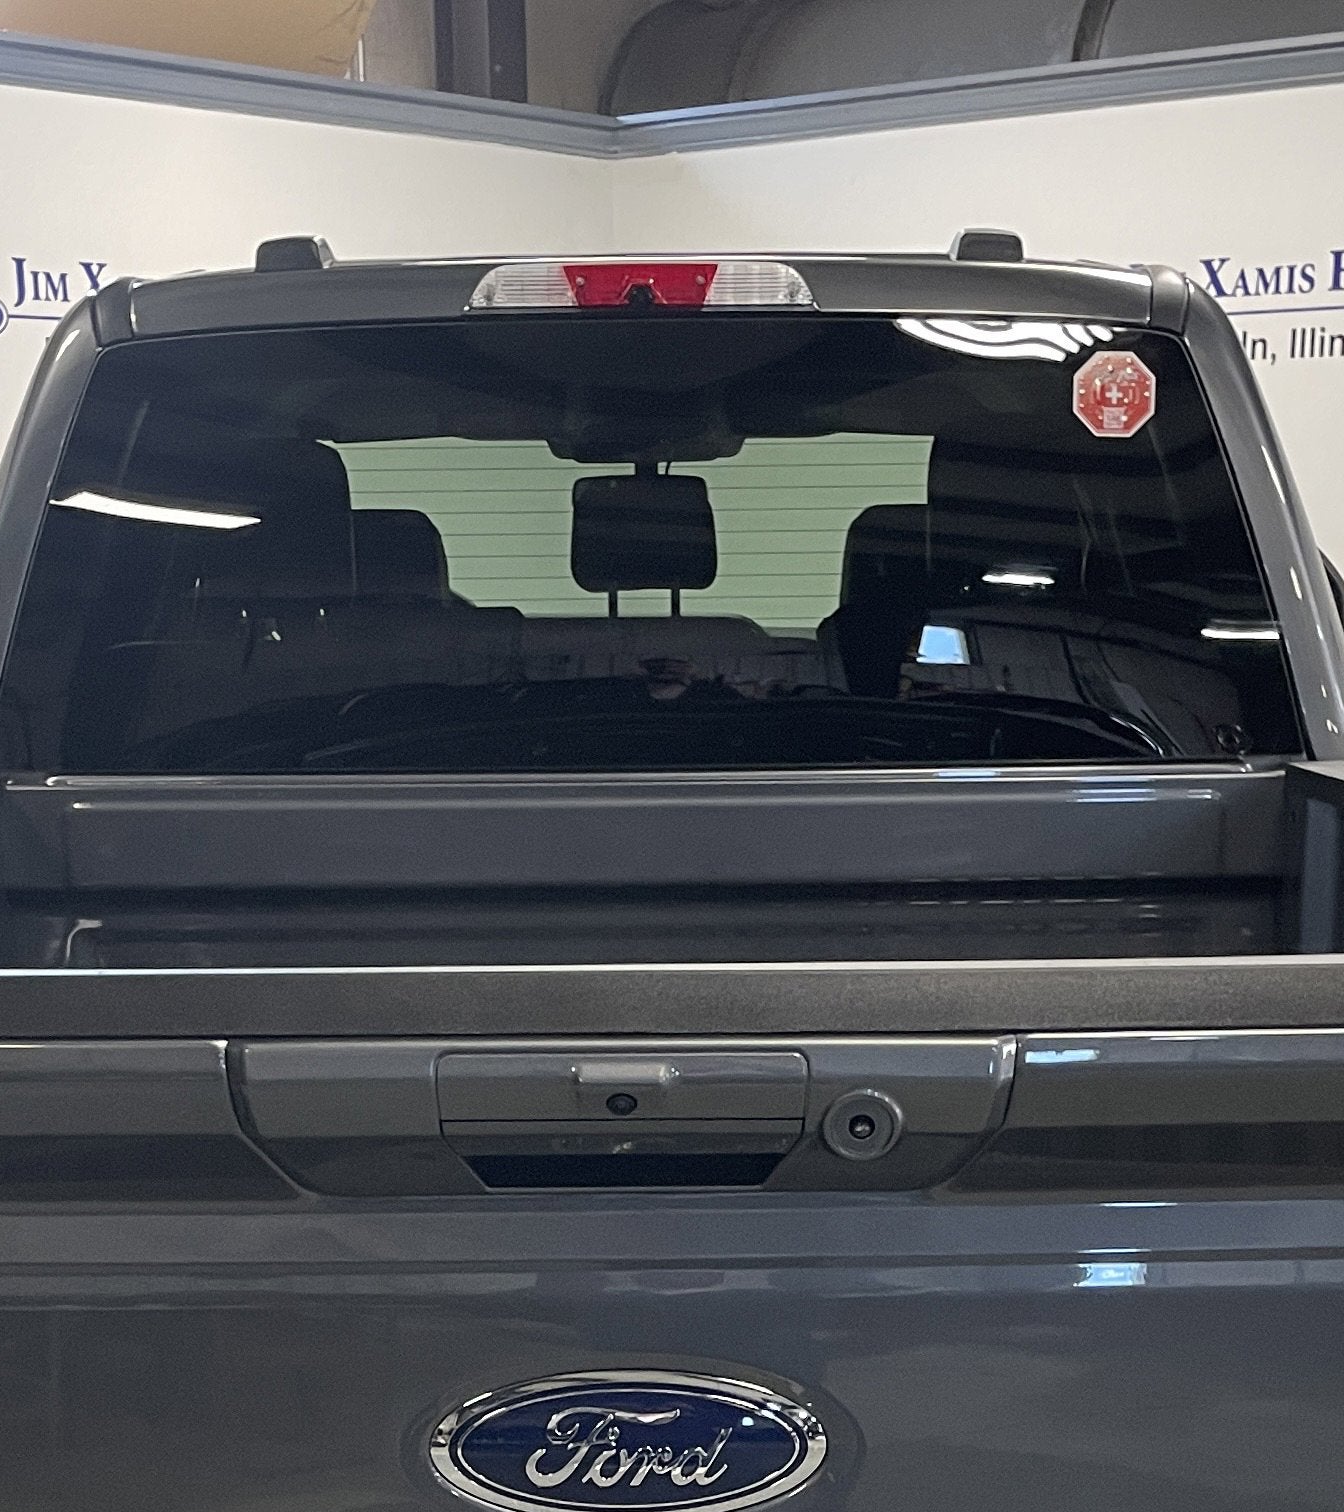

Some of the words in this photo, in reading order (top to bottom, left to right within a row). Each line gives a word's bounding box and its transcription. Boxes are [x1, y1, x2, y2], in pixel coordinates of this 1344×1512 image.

[11, 256, 71, 308] JIM
[1199, 256, 1317, 298] XAMIS
[525, 1405, 734, 1489] Ford
